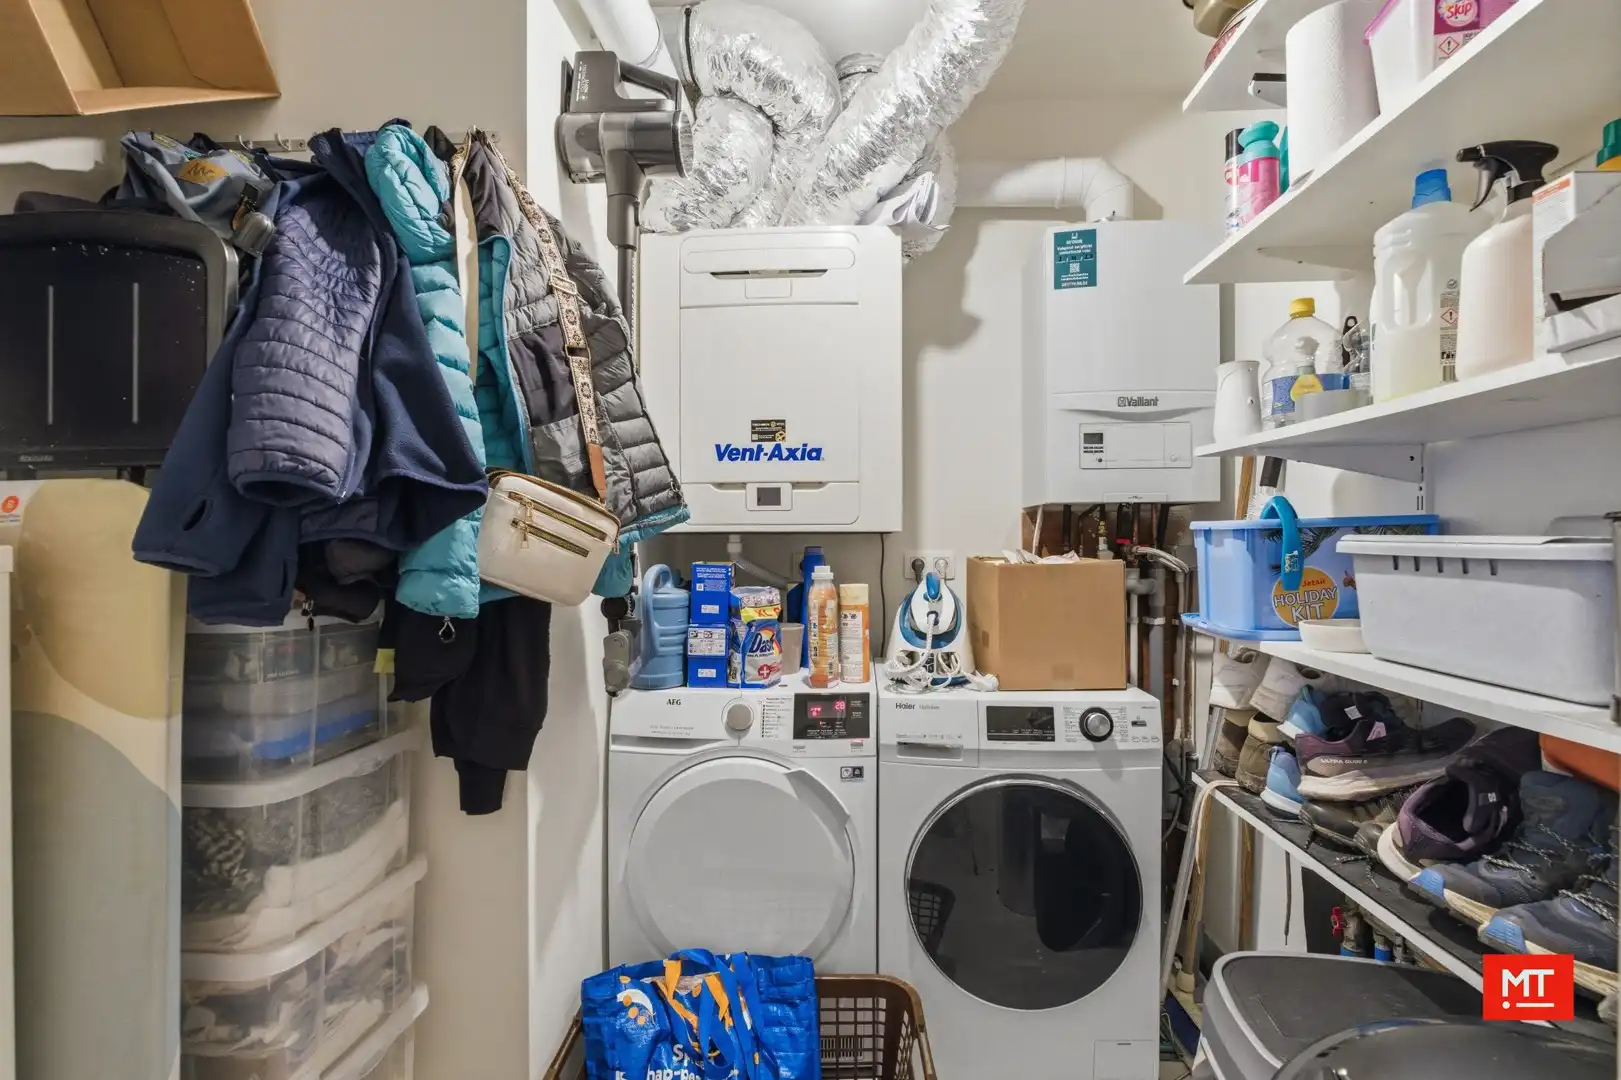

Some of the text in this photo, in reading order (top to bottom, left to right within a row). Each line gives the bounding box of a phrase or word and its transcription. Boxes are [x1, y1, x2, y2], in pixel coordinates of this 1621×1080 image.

[1126, 396, 1160, 407] Vaillant
[714, 443, 823, 462] Vent-Axia
[1273, 586, 1338, 607] HOLIDAY
[1291, 602, 1325, 623] KIT
[748, 632, 776, 654] Dash
[666, 698, 682, 706] AEG
